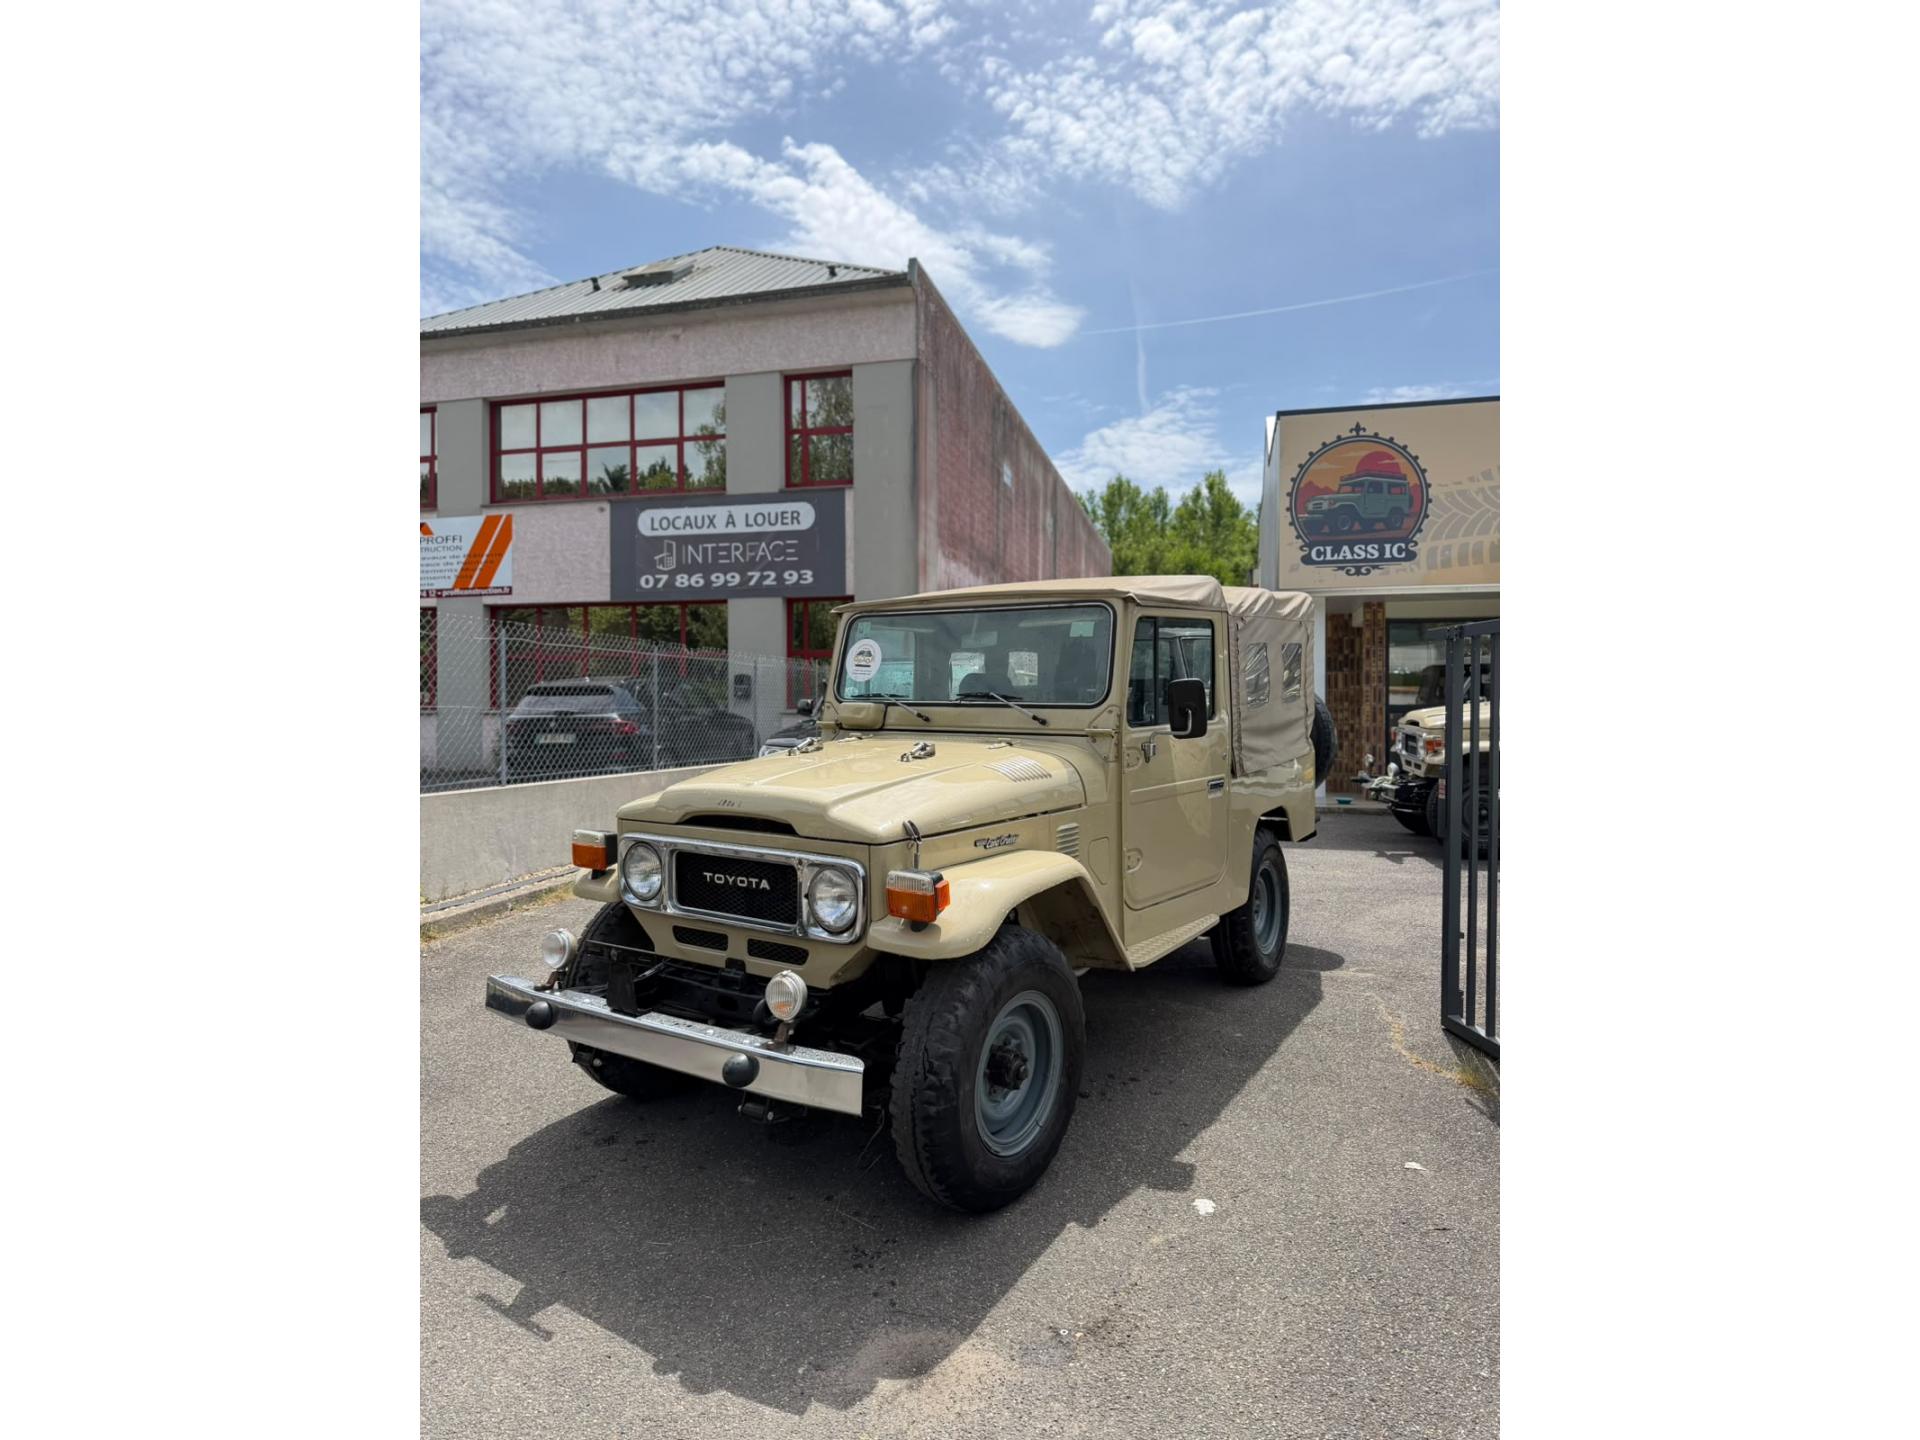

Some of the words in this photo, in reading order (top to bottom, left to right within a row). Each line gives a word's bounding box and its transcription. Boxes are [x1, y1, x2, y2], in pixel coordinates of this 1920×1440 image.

[650, 514, 717, 532] LOCAUX
[725, 510, 736, 529] À
[745, 510, 801, 528] LOUER
[682, 540, 799, 565] INTERFACE
[639, 574, 669, 589] 07
[675, 573, 705, 588] 86
[710, 572, 741, 587] 99
[747, 570, 777, 586] 72
[783, 569, 814, 584] 93
[703, 872, 770, 891] TOYOTA
